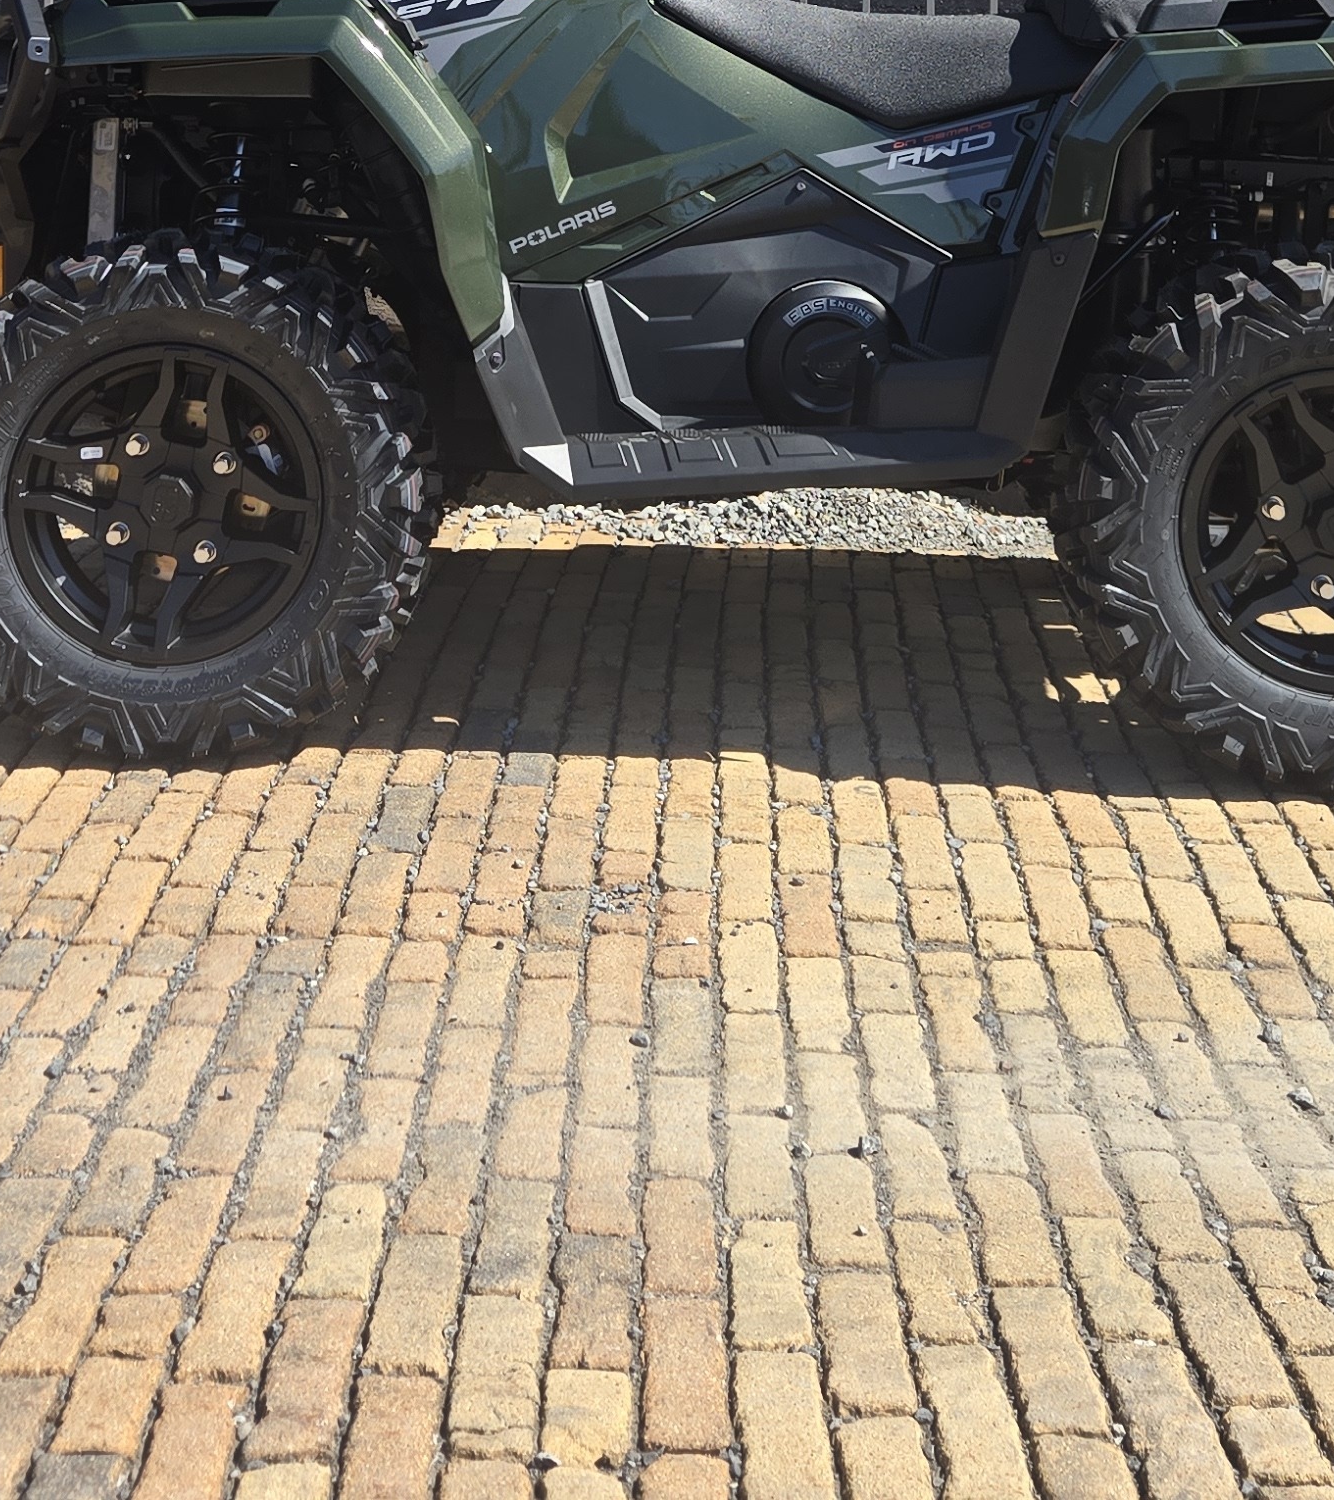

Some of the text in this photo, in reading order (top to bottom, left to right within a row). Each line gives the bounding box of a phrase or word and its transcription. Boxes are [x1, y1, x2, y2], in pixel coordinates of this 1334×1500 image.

[886, 130, 997, 171] AWD
[508, 200, 617, 255] POLARIS
[788, 298, 874, 325] EBS ENGINE
